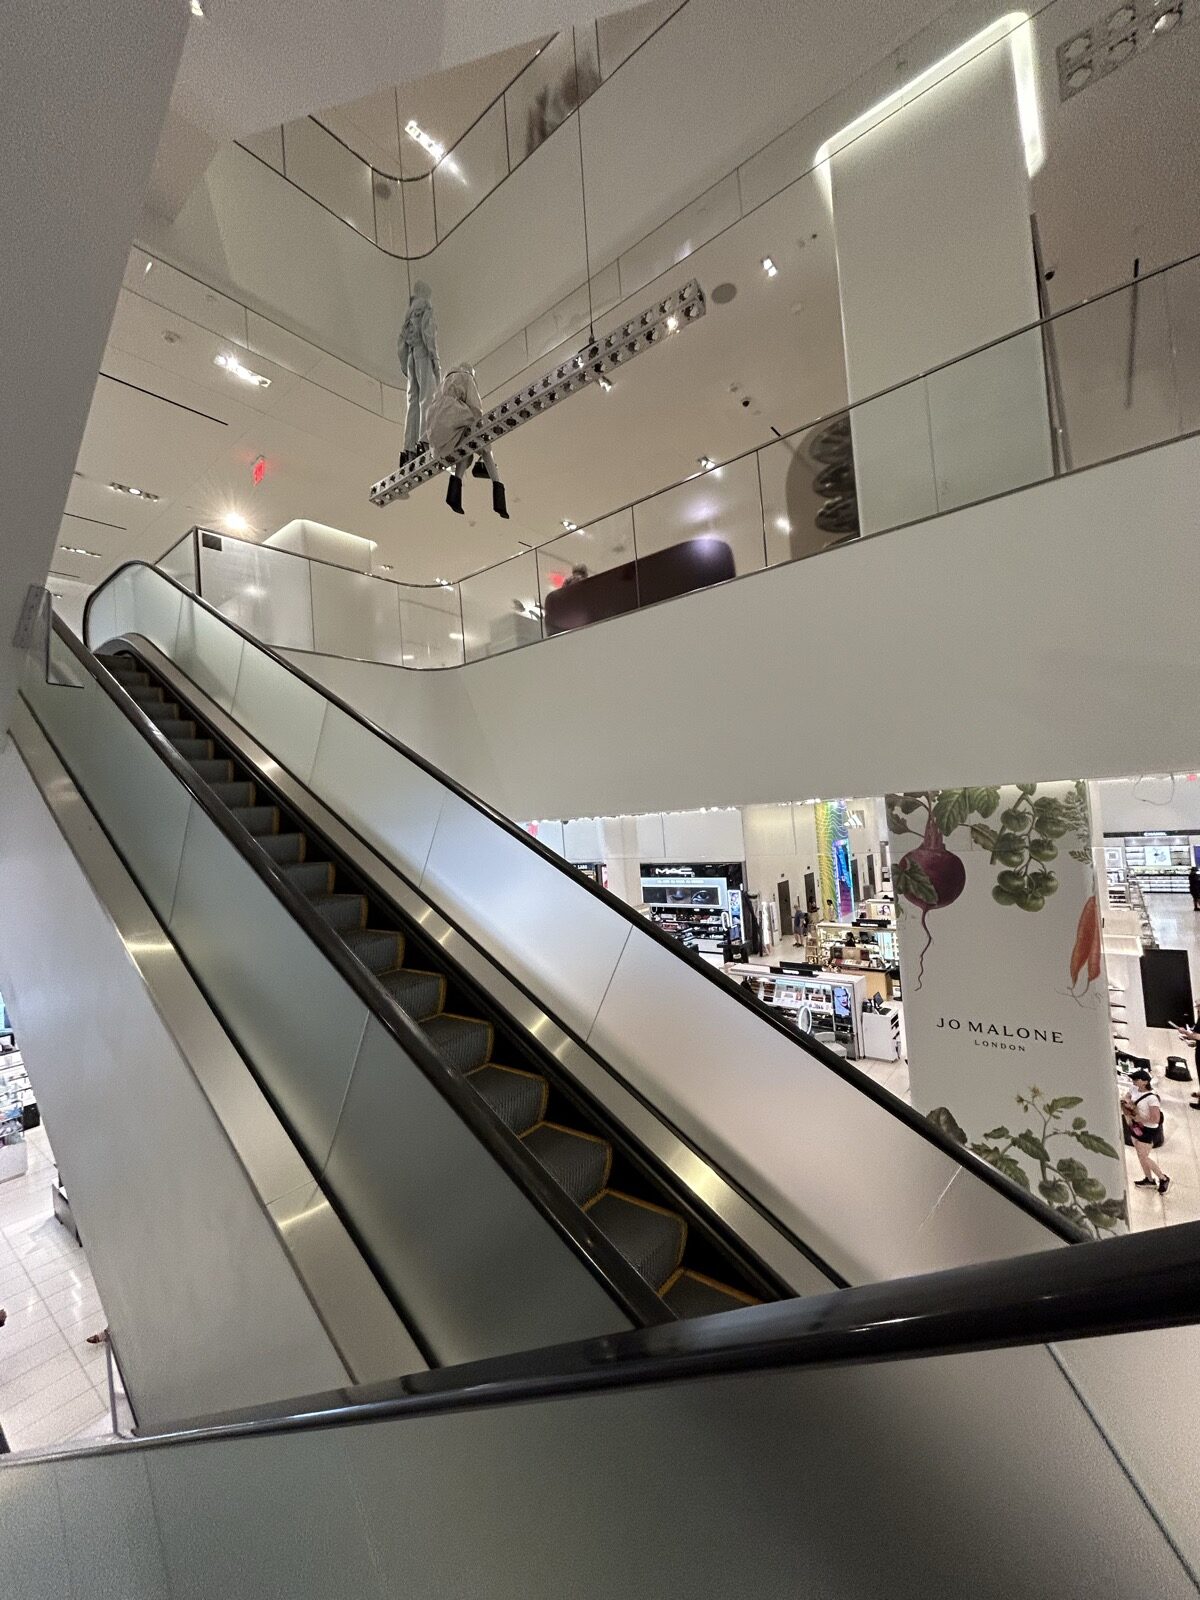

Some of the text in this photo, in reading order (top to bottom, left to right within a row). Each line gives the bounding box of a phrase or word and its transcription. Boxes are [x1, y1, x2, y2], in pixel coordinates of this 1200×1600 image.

[936, 1018, 1064, 1044] JO MALONE
[974, 1039, 1025, 1052] LONDON
